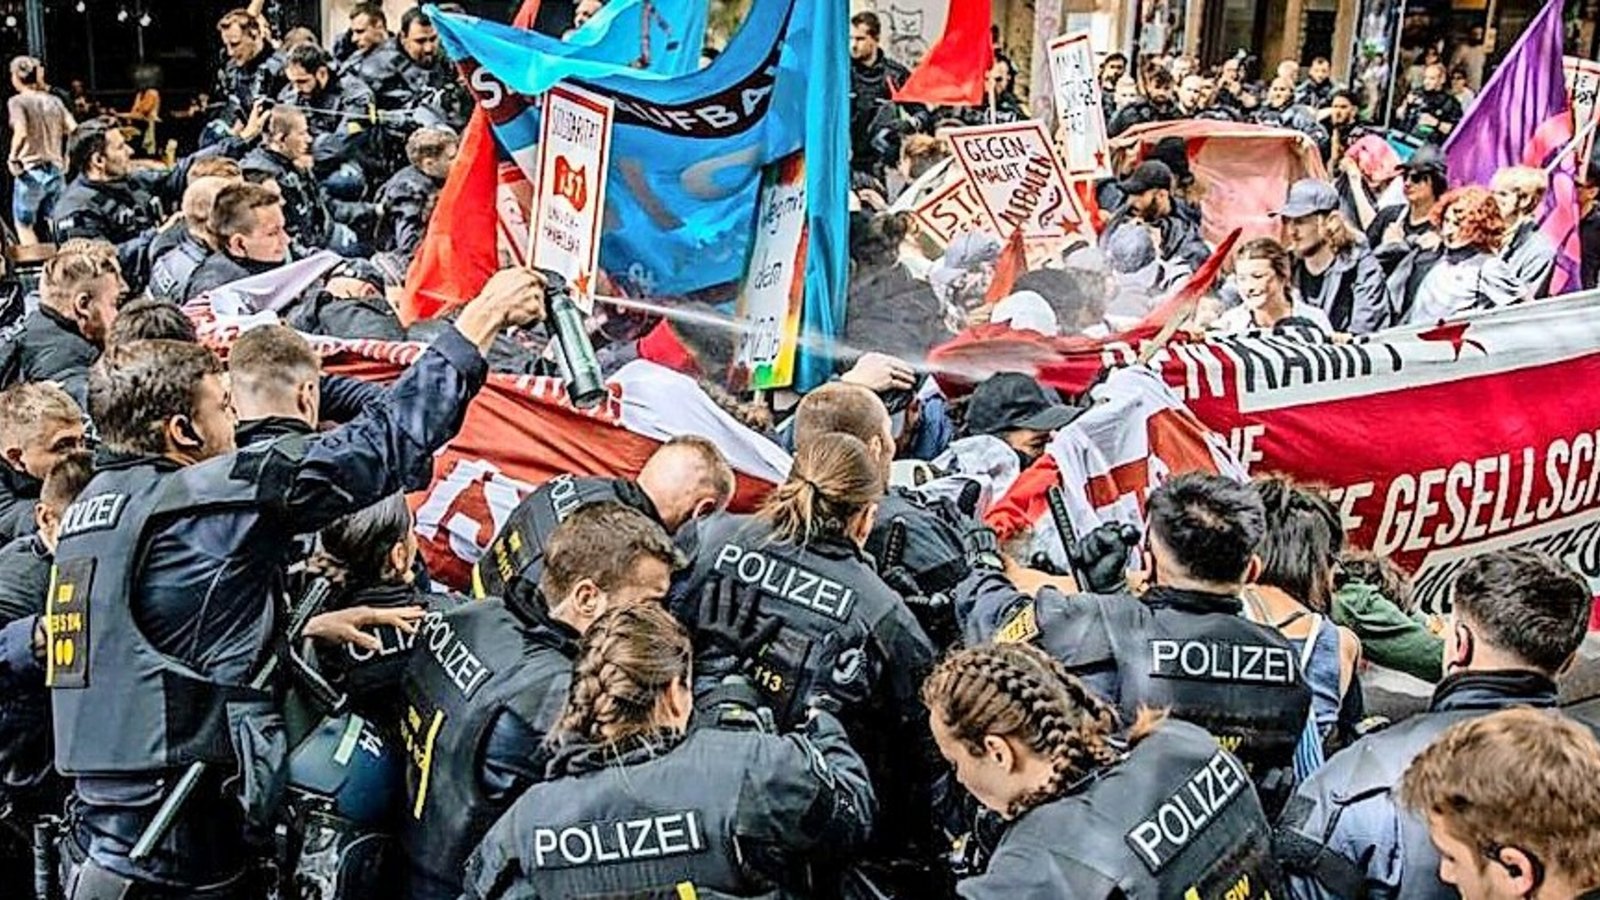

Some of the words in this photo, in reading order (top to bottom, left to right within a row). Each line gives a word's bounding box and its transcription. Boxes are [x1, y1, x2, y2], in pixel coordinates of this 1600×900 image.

[964, 136, 1031, 162] GEGEN-
[974, 162, 1023, 185] MACHT
[714, 544, 853, 618] POLIZEI
[424, 611, 488, 694] POLIZEI
[1152, 640, 1295, 683] POLIZEI
[1129, 749, 1246, 867] POLIZEI
[535, 811, 701, 867] POLIZEI
